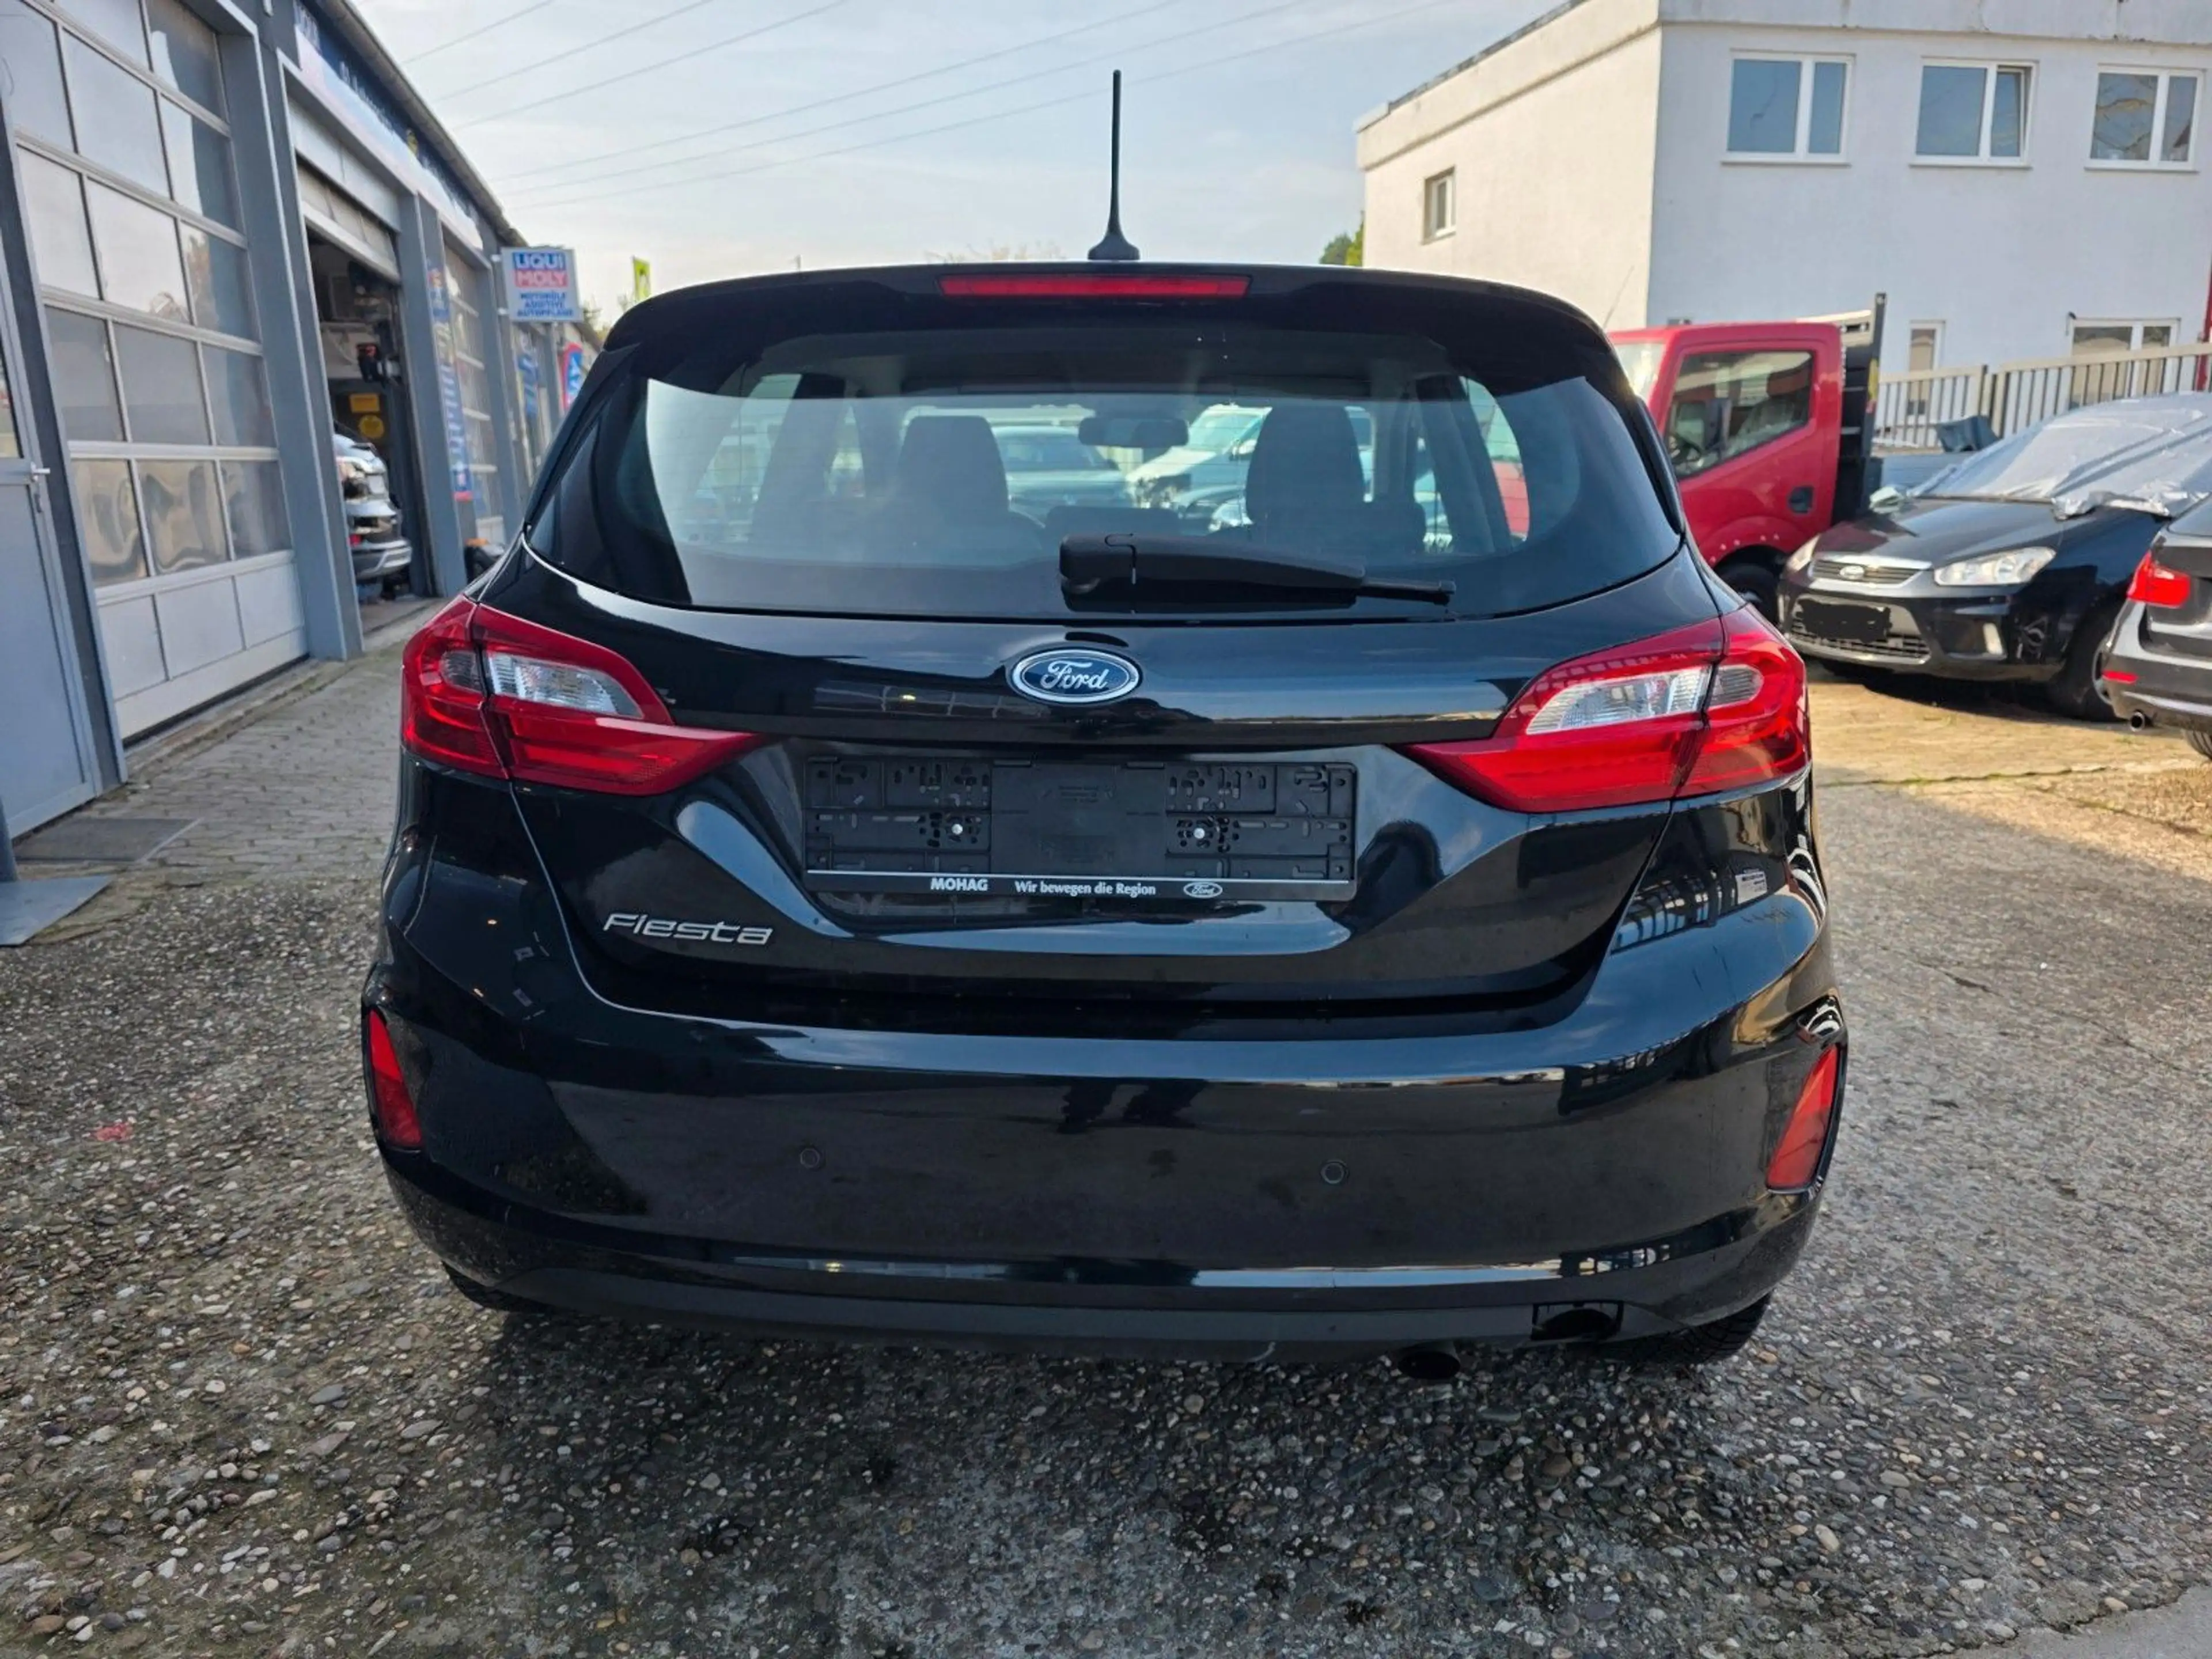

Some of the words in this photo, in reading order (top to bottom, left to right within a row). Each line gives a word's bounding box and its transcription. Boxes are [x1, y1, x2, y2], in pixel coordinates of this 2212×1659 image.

[514, 253, 564, 268] LIQUI
[516, 270, 567, 287] MOLY
[1040, 660, 1109, 690] Ford
[930, 877, 988, 891] MOHAG
[1014, 880, 1037, 893] Wir
[1040, 881, 1092, 897] bewegen
[1094, 881, 1113, 894] die
[1116, 882, 1156, 898] Region
[603, 913, 773, 946] Fiesta
